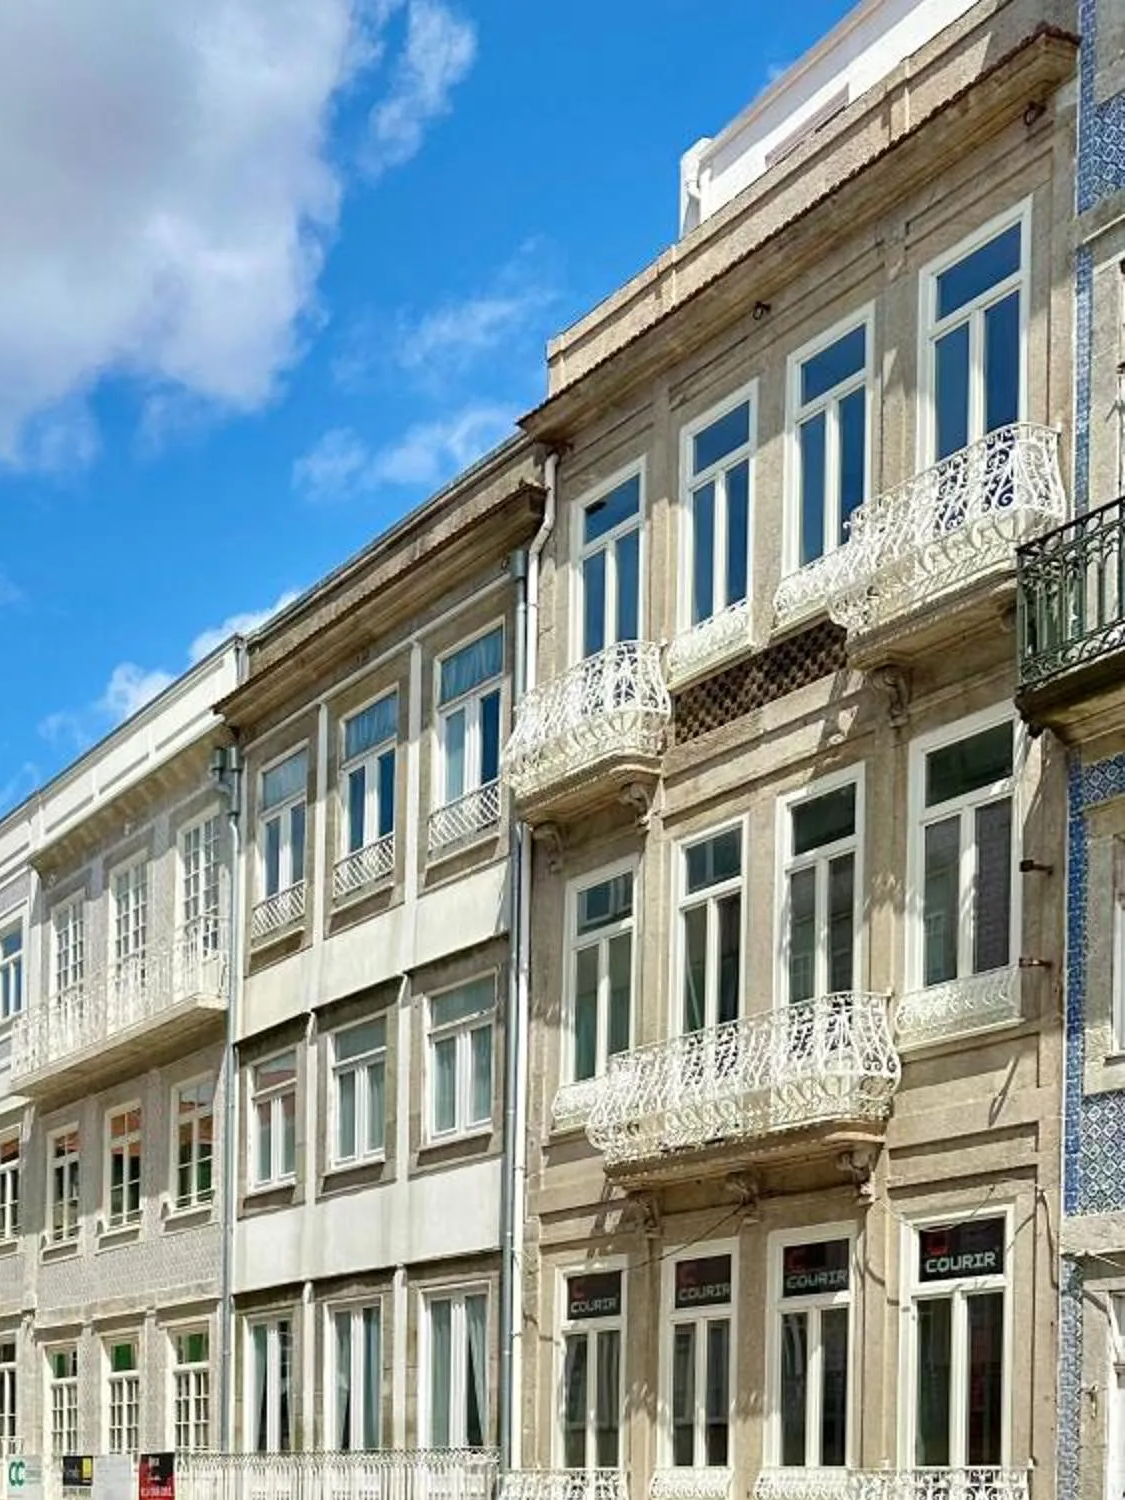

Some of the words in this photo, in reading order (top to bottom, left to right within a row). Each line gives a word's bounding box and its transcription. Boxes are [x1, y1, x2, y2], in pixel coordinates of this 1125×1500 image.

[925, 1251, 997, 1273] COURIR
[786, 1269, 848, 1289] COURIR
[678, 1282, 732, 1301] COURIR
[570, 1297, 618, 1313] COURIR
